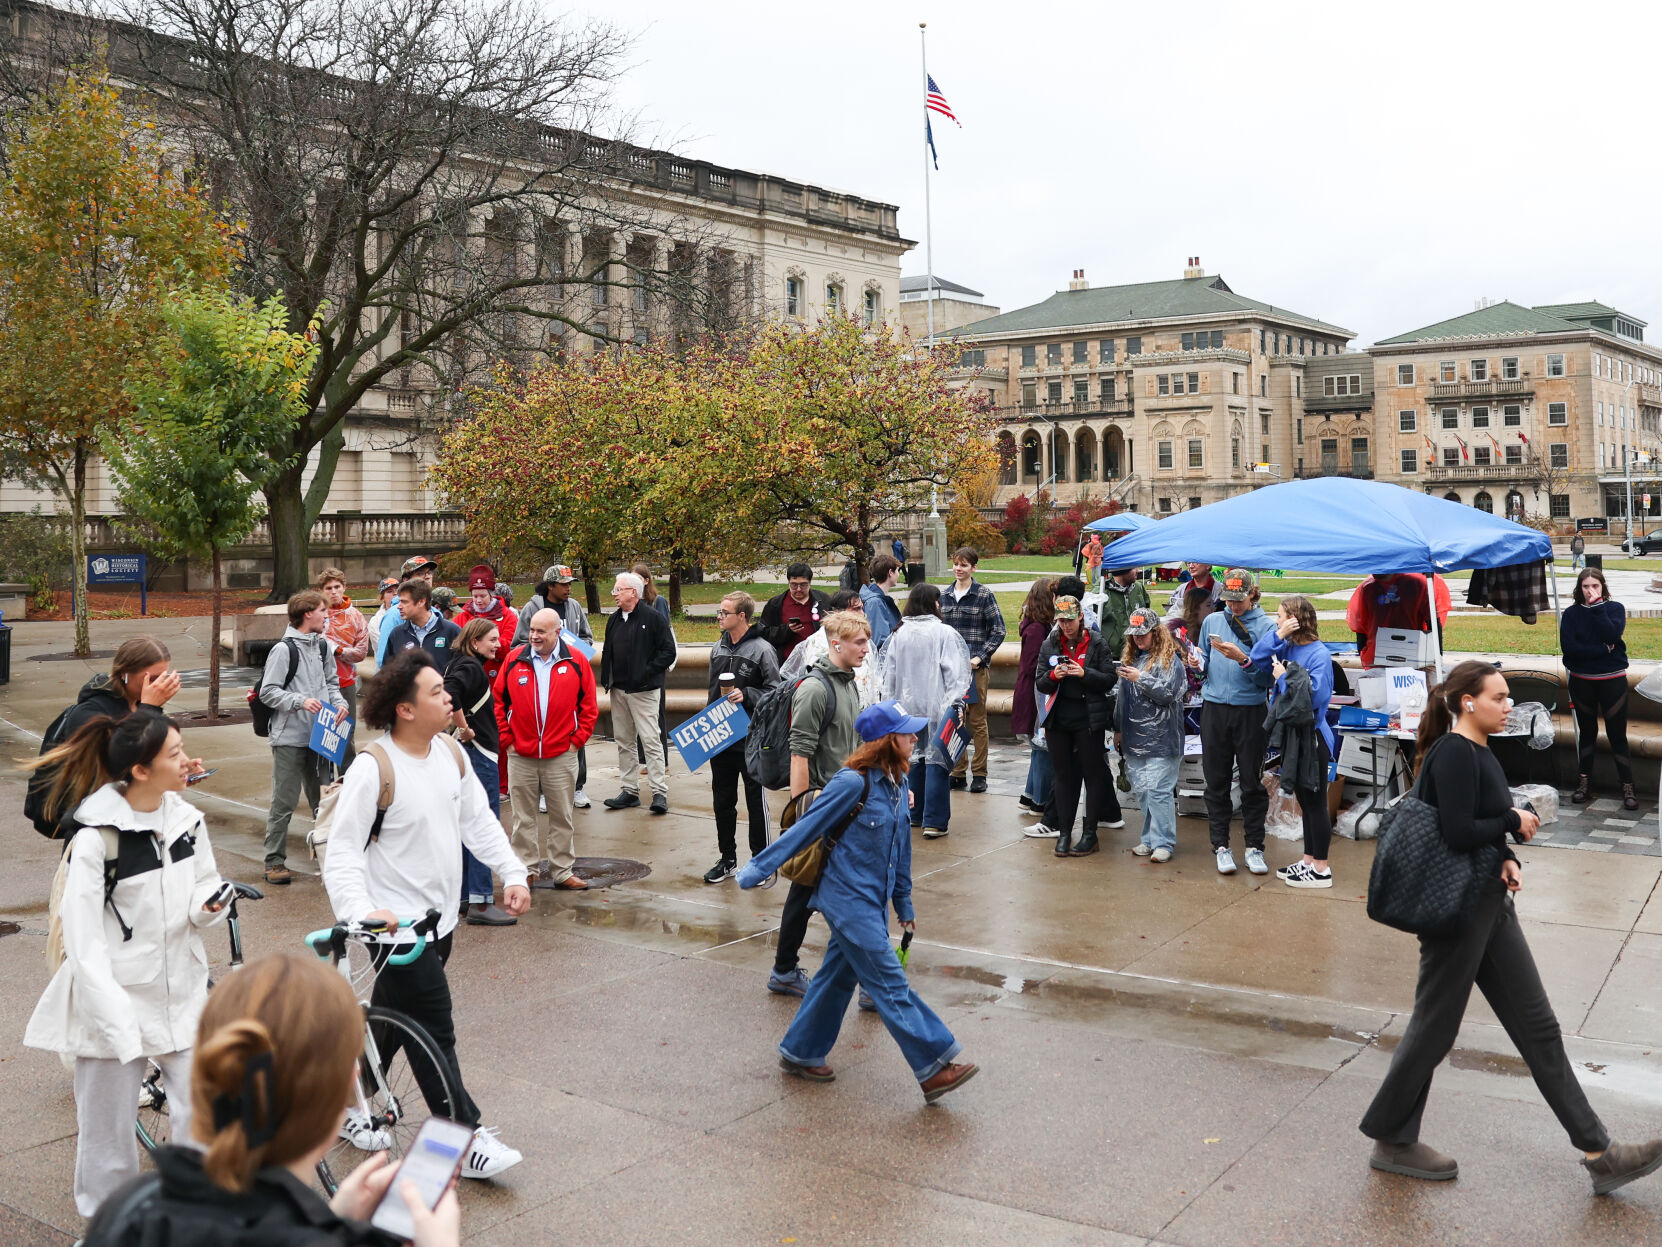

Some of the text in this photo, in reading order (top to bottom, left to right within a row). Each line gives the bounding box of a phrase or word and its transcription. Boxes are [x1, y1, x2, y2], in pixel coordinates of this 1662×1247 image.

[675, 716, 711, 748] LET'S
[707, 700, 739, 725] WIN
[697, 720, 734, 753] THIS!
[321, 728, 340, 754] THIS!
